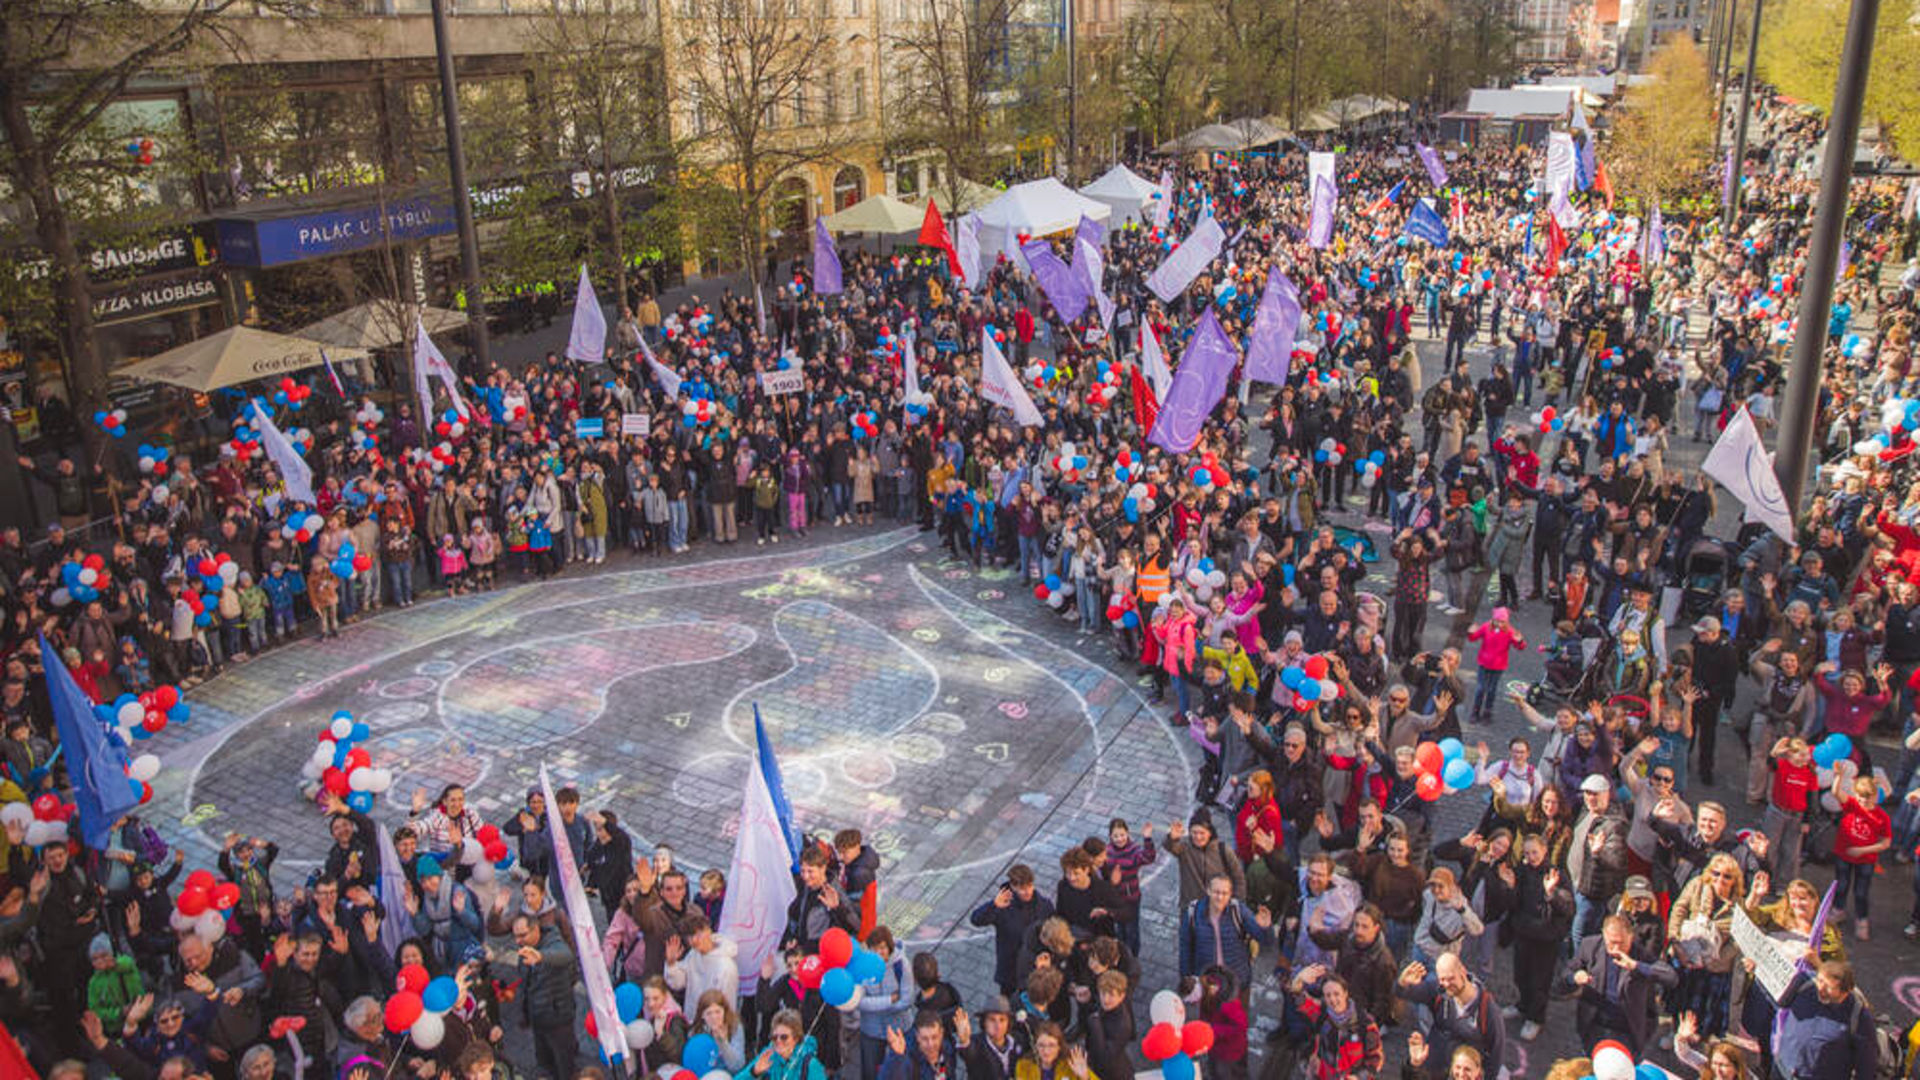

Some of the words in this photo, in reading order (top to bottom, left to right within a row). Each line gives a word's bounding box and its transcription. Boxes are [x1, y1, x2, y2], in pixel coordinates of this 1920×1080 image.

[360, 219, 369, 235] U
[91, 239, 186, 270] SAUSAGE
[141, 280, 215, 306] KLOBÁSA
